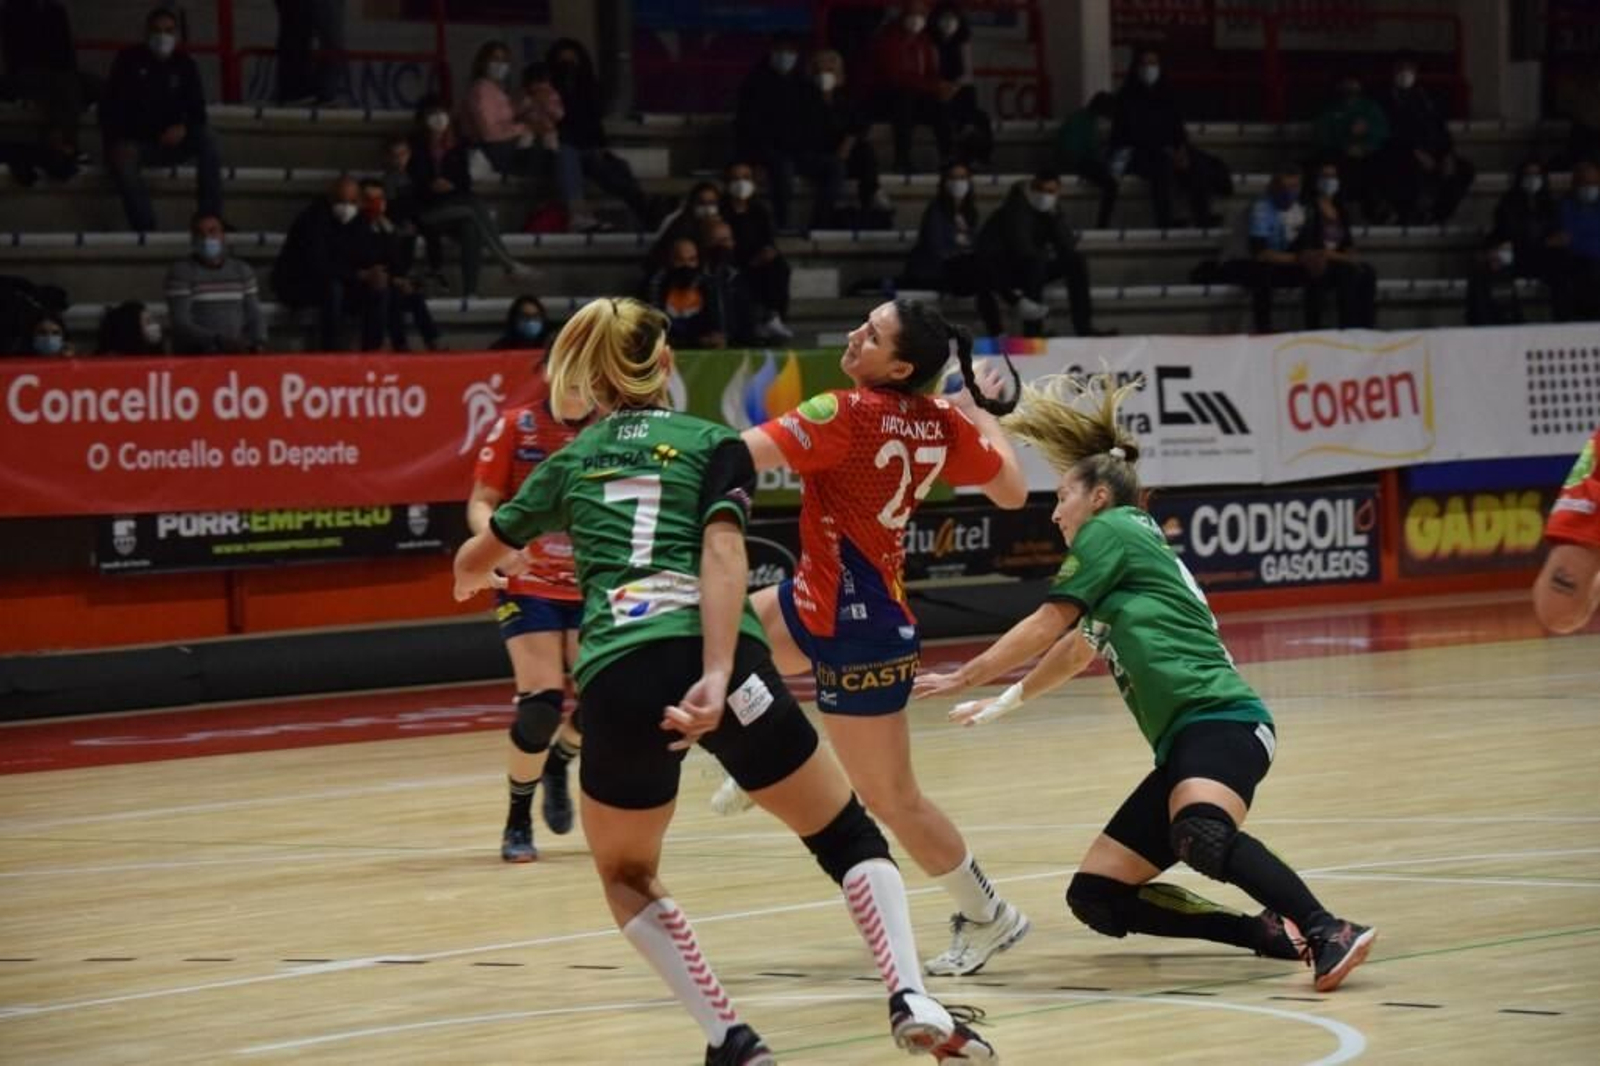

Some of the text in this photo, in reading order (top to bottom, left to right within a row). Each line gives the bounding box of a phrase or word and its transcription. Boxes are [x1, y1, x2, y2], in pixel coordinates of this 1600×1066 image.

[8, 370, 427, 424] Concello do Porriño
[87, 437, 360, 472] O Concello do Deporte
[582, 449, 648, 471] PIEDRA
[875, 439, 948, 529] 27
[603, 473, 662, 568] 7
[1190, 498, 1370, 557] CODISOIL
[1405, 490, 1543, 560] GADIS
[1260, 548, 1370, 584] GASÓLEOS
